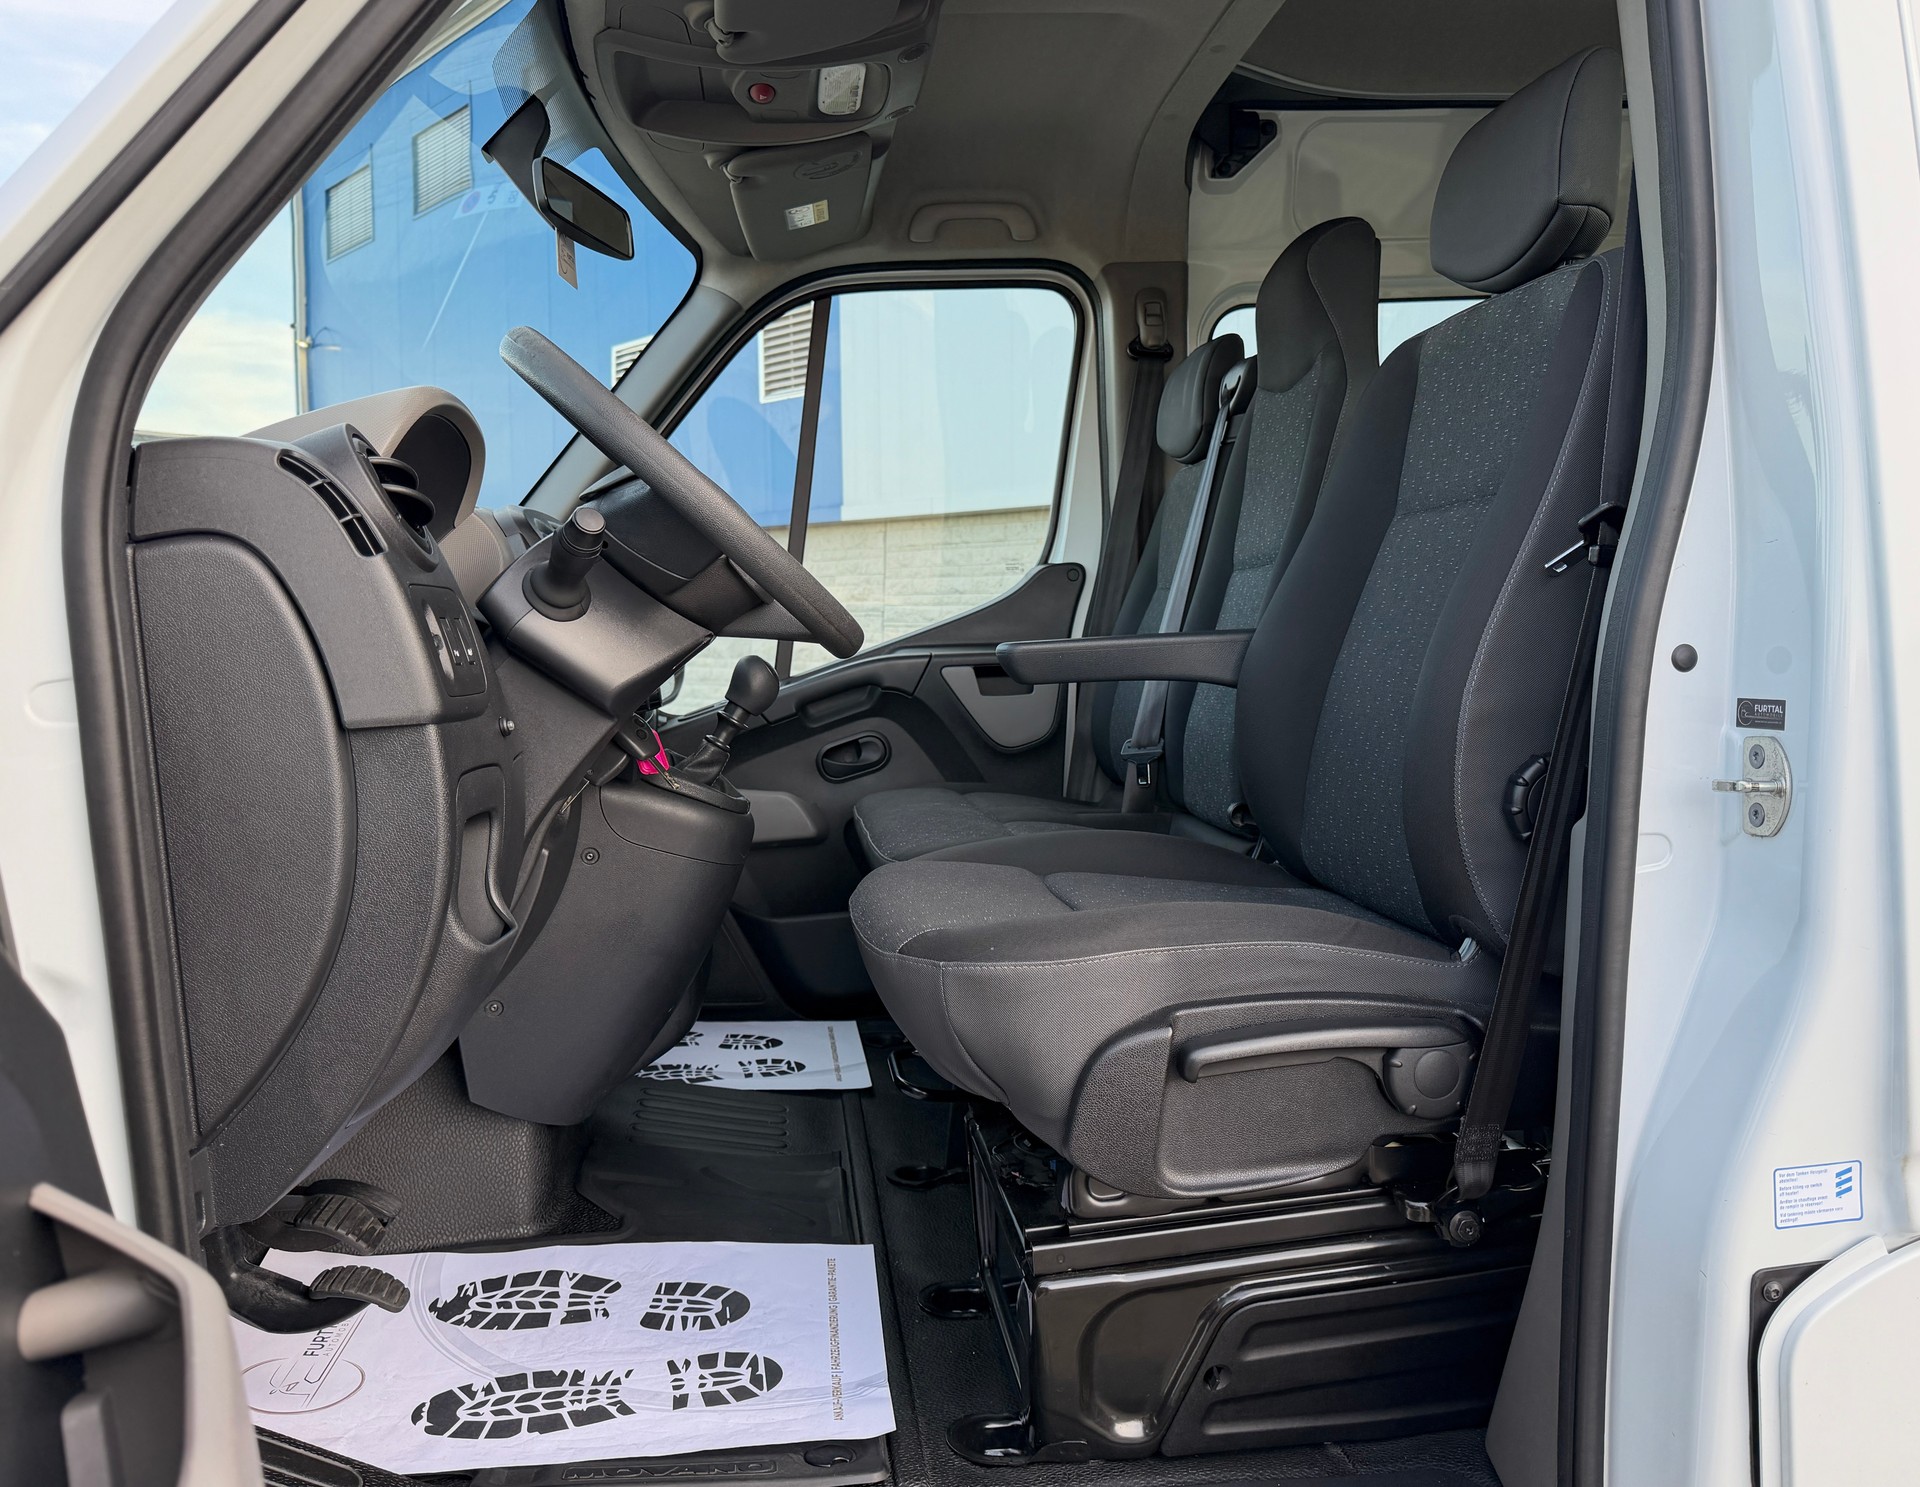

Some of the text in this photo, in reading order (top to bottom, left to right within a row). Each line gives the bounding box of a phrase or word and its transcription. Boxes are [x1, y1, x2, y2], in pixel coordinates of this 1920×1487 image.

[1755, 704, 1783, 713] FURTTAL
[827, 1258, 844, 1421] ANKAUF-VERKAUF FAHRZEUGFINANZIERUNG GARANTIE-PAKETE
